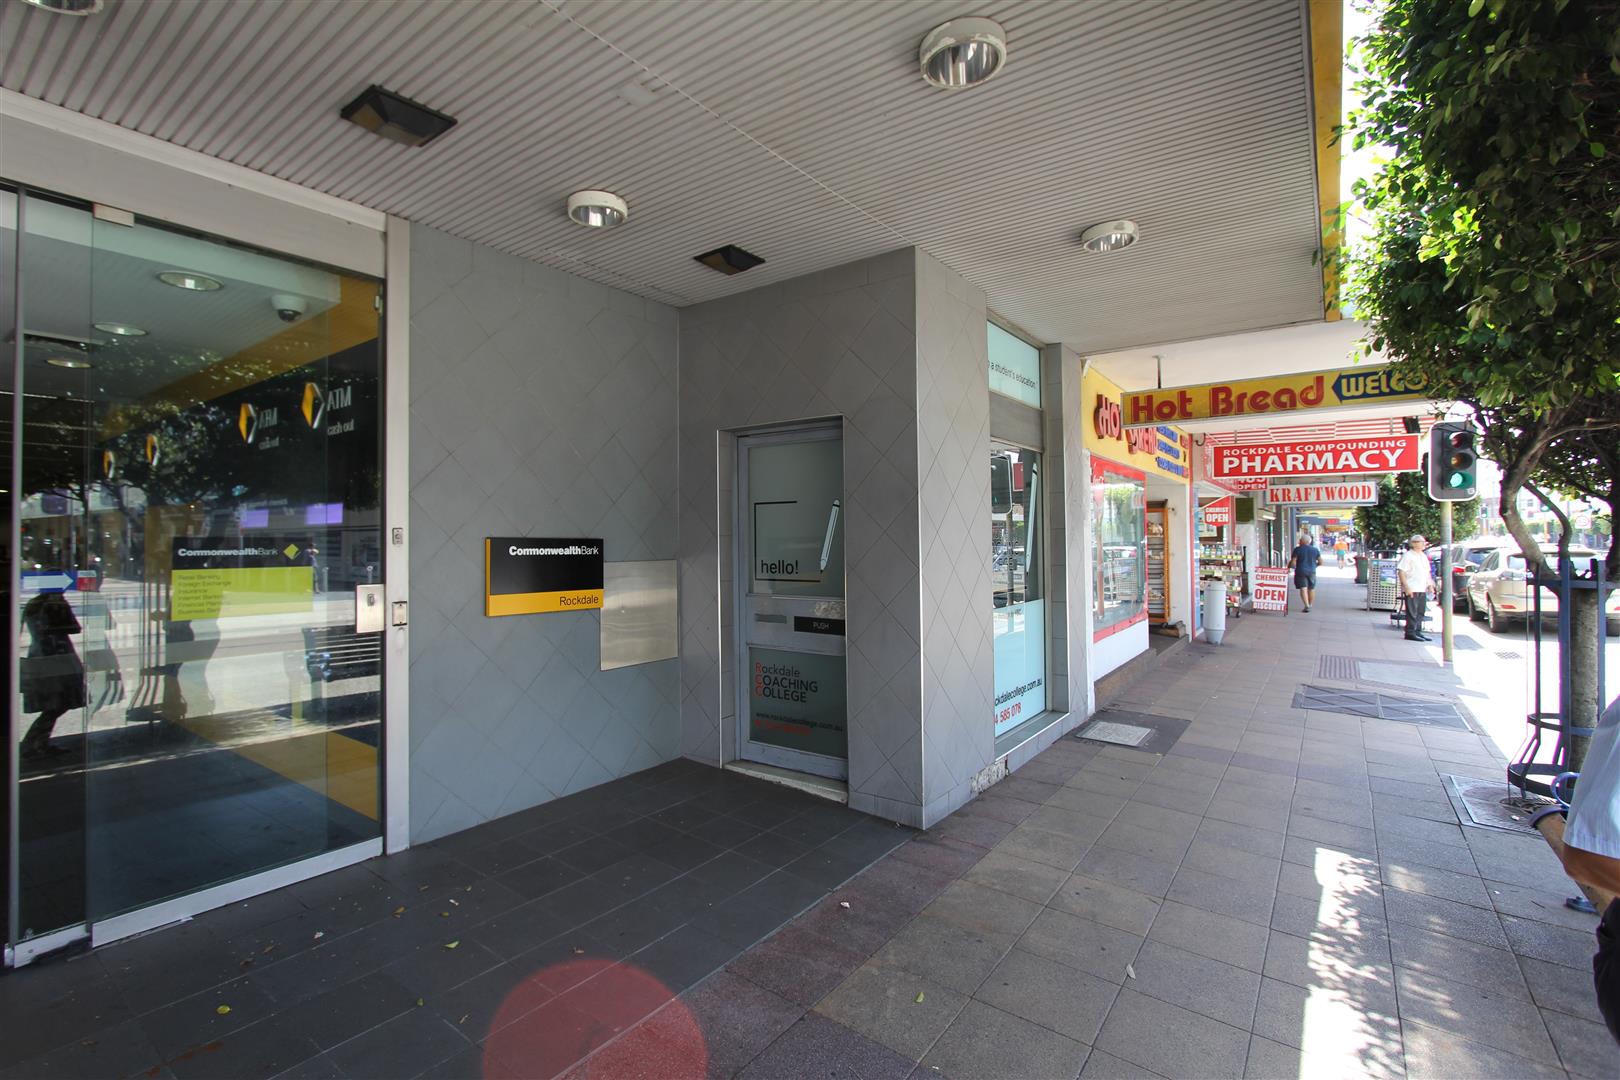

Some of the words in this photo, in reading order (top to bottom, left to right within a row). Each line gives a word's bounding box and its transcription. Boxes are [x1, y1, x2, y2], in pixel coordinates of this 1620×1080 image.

[1341, 372, 1428, 398] WELCO
[327, 385, 352, 412] ATM
[1131, 390, 1193, 423] Hot
[1209, 375, 1325, 417] Bread
[1223, 445, 1291, 457] ROCKDALE
[1295, 440, 1407, 453] COMPOUNDING
[1223, 448, 1405, 474] PHARMACY
[1270, 484, 1372, 503] KRAFTWOOD
[1206, 513, 1229, 522] OPEN
[177, 547, 279, 557] CommonwealthBank
[508, 545, 600, 556] CommonwealthBank
[761, 559, 799, 575] hello!
[1255, 574, 1286, 582] CHEMIST
[559, 595, 600, 607] Rockdale
[1255, 588, 1285, 602] OPEN
[1253, 601, 1286, 611] DISCOUNT
[812, 621, 830, 630] PUSH
[755, 661, 801, 678] Rockdale
[755, 673, 818, 693] COACHING
[755, 686, 807, 703] COLLEGE
